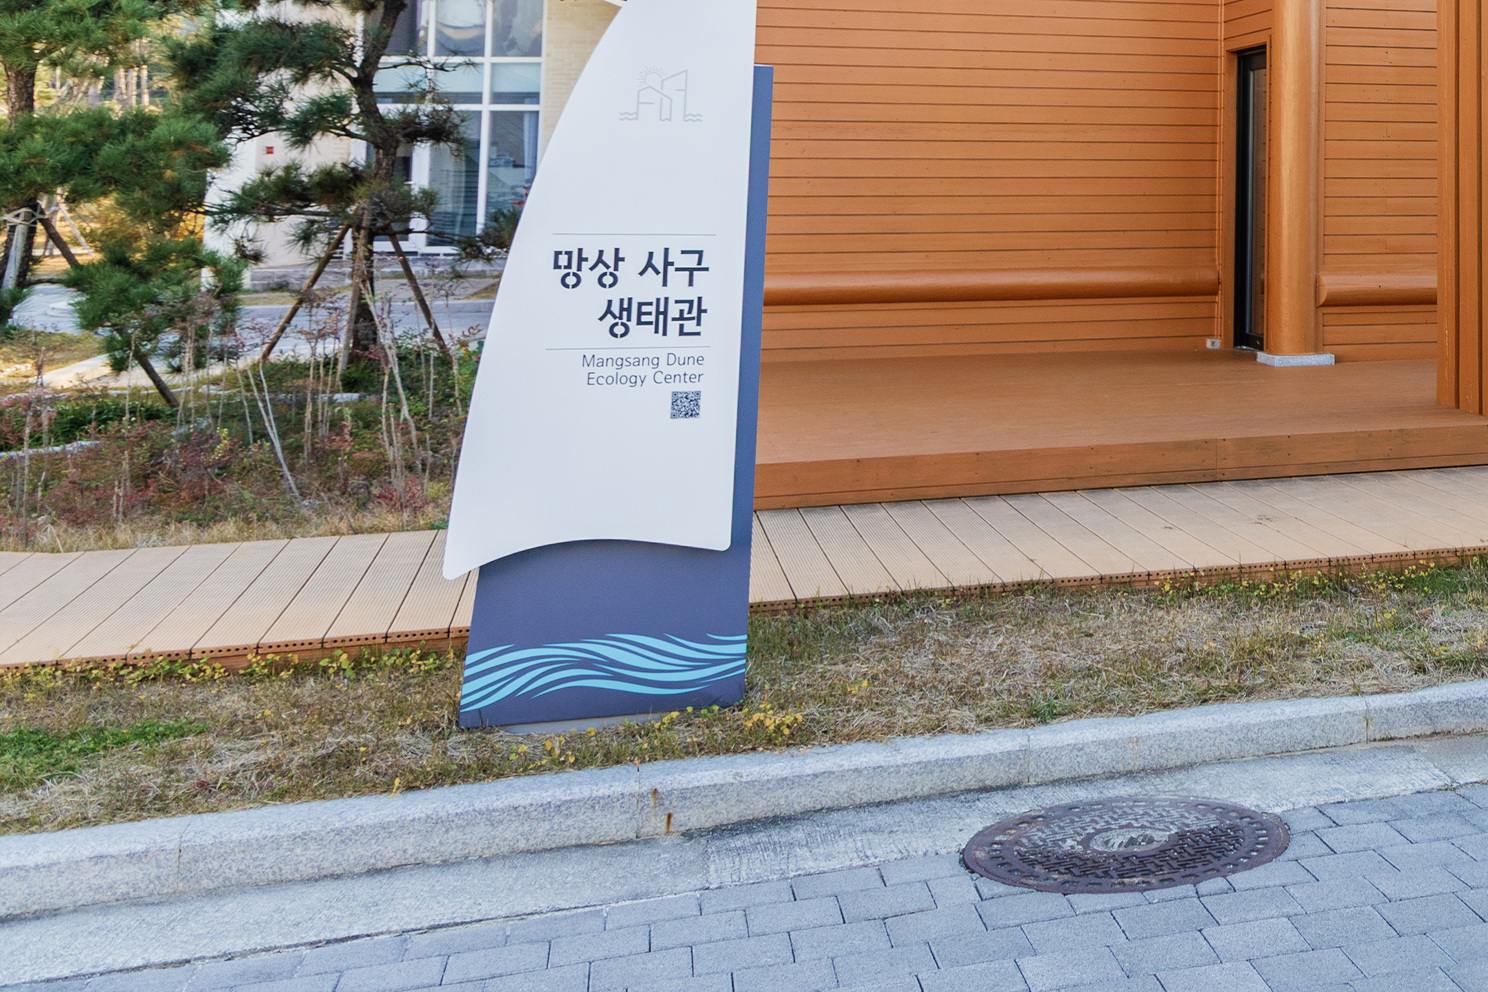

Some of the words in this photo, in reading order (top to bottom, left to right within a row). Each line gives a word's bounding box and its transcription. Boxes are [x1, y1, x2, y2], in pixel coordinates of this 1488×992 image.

[553, 247, 626, 289] 망상
[638, 247, 709, 287] 사구
[598, 296, 708, 339] 생태관
[582, 353, 660, 370] Mangsang
[666, 352, 705, 366] Dune
[587, 372, 647, 388] Ecology
[653, 370, 704, 384] Center
